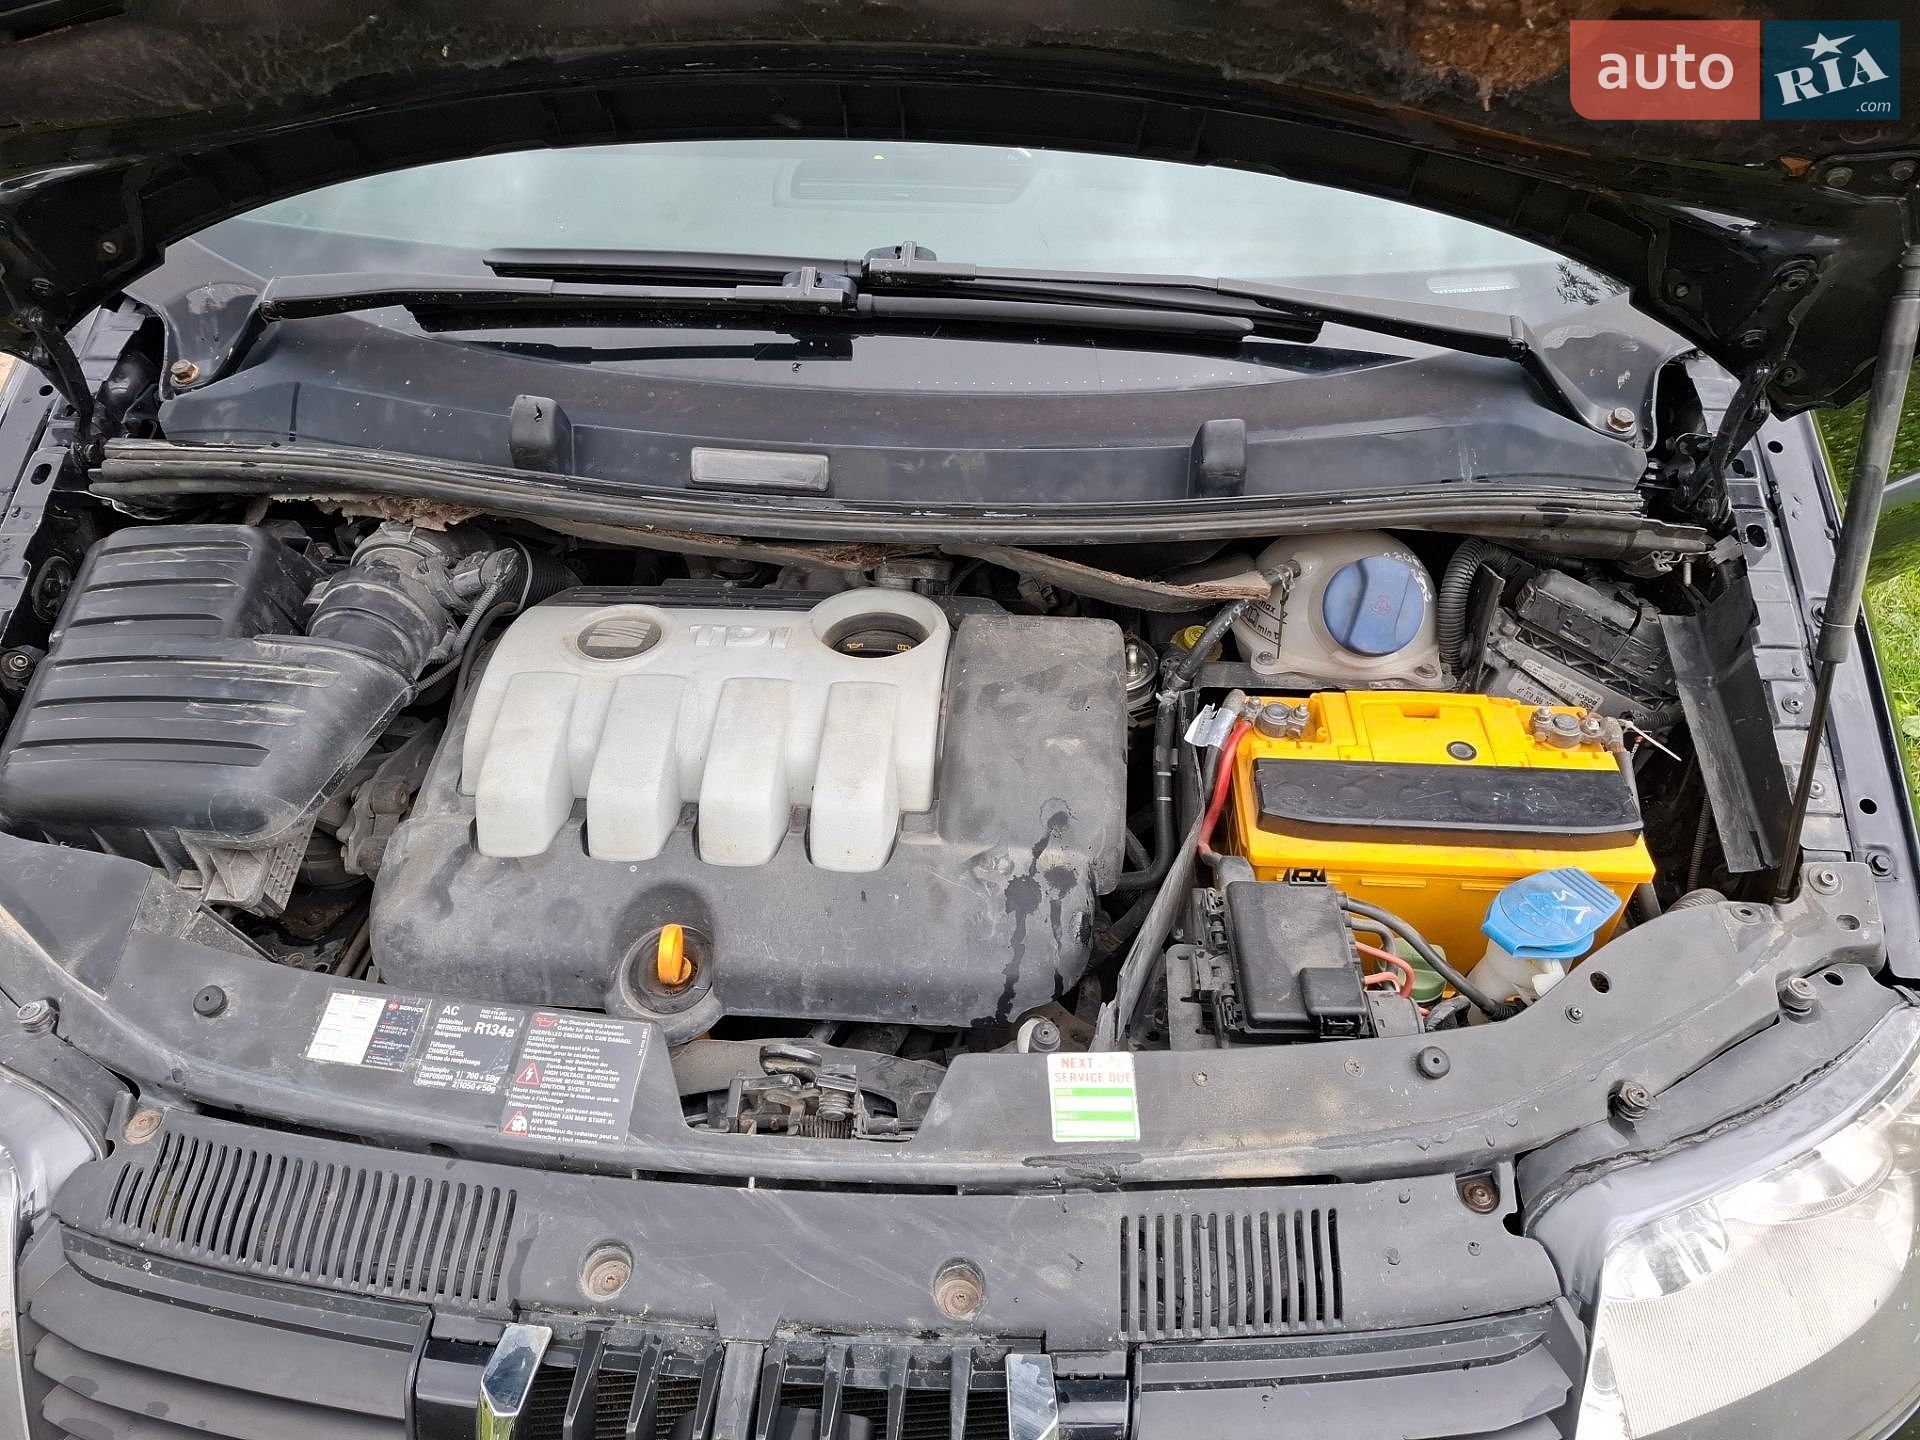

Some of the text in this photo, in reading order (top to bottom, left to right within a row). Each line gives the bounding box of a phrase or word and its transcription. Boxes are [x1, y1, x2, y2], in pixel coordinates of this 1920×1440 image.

[689, 624, 792, 649] TDI
[1257, 624, 1272, 637] min
[442, 1005, 459, 1015] AC
[474, 1022, 515, 1037] R134a
[1061, 1058, 1093, 1069] NEXT
[1055, 1072, 1132, 1083] SERVICE DUE
